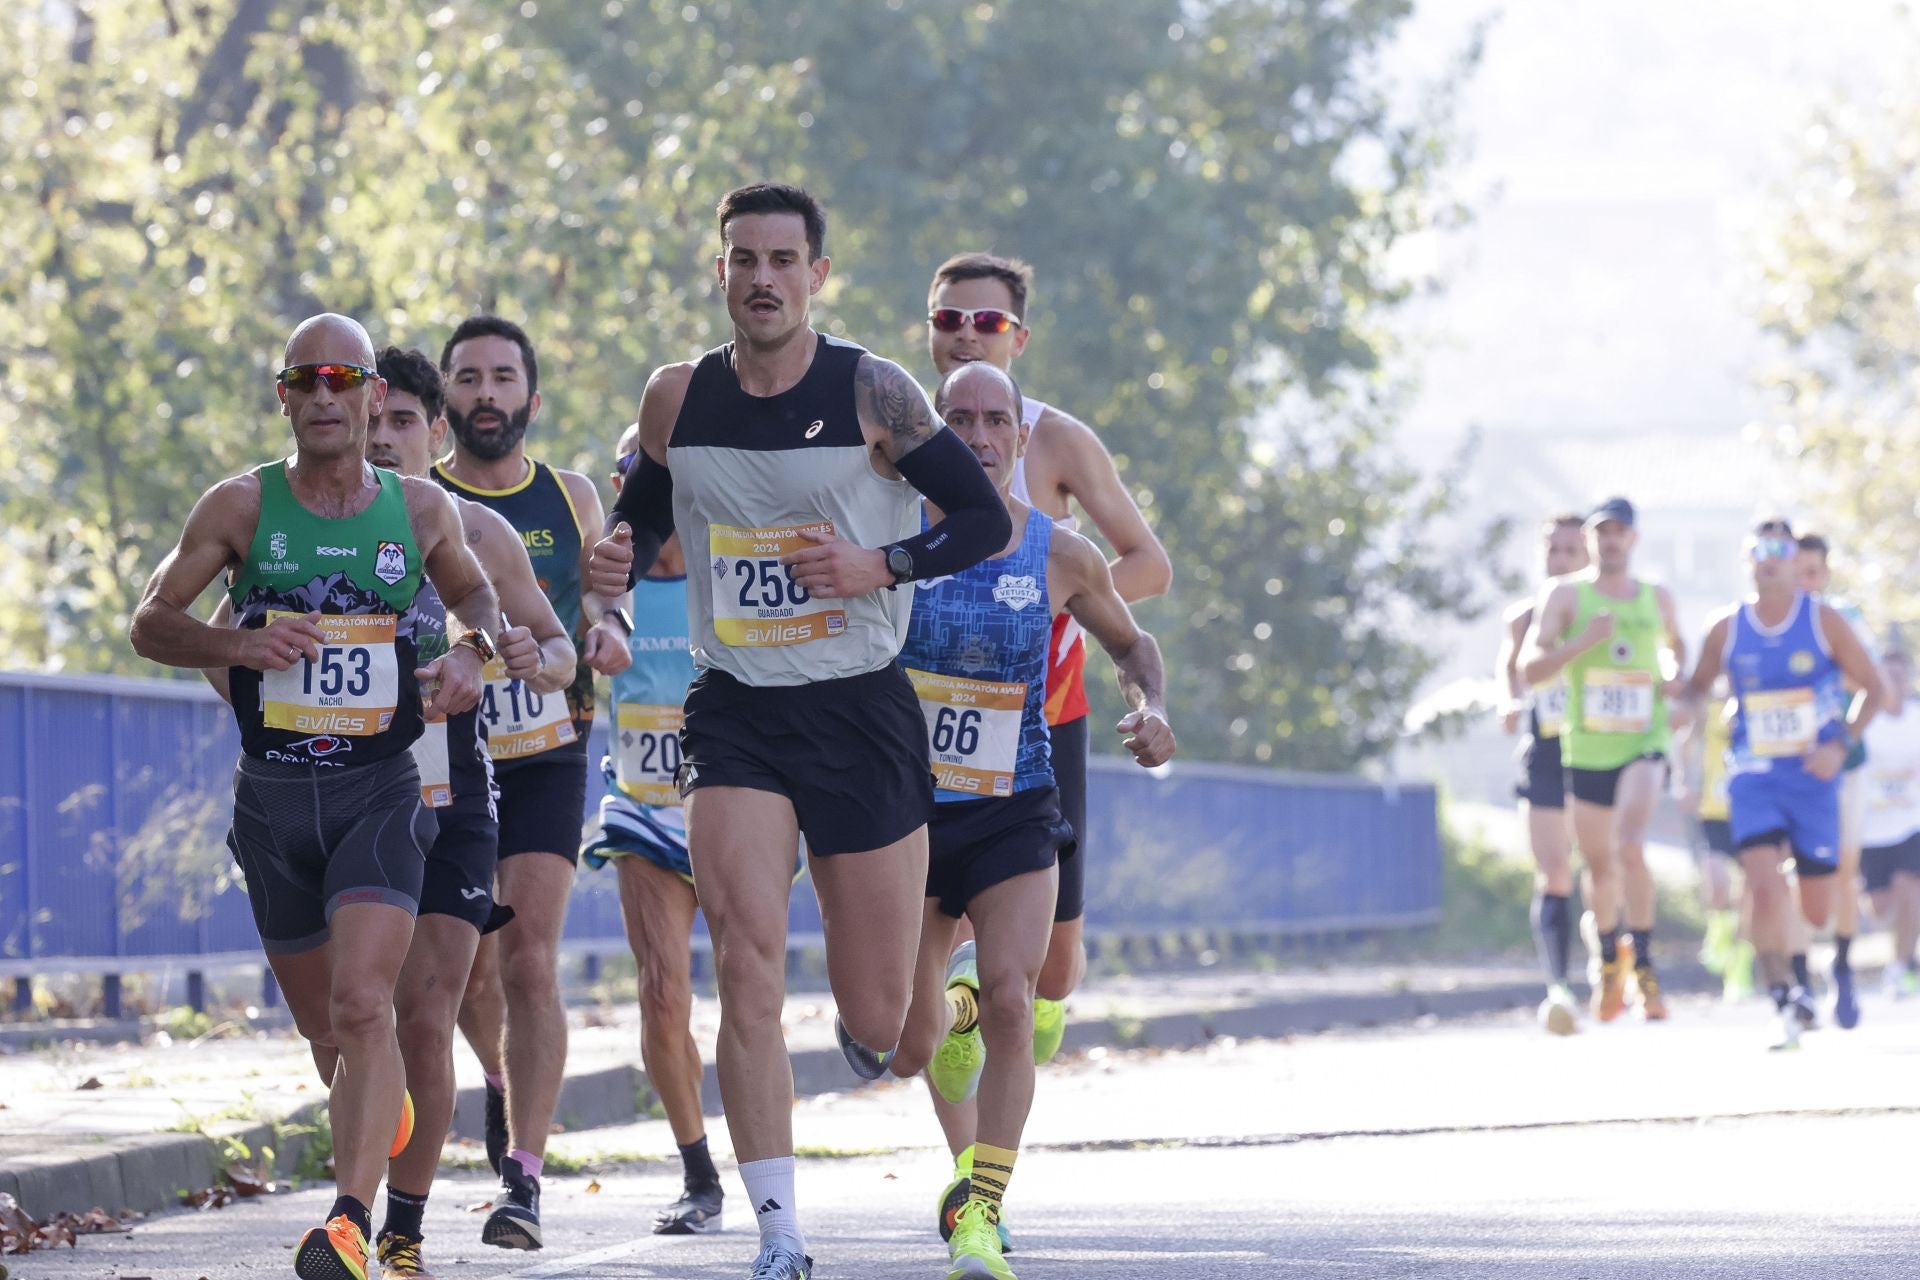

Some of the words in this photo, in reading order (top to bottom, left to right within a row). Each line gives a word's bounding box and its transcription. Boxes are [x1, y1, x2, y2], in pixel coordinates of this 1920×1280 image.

[518, 529, 554, 547] NES
[753, 543, 780, 552] 2024
[258, 561, 272, 571] Villa
[273, 561, 282, 571] de
[283, 561, 299, 573] Noja
[999, 590, 1036, 599] VETUSTA
[757, 607, 794, 618] GUARDADO
[324, 617, 368, 627] MARATÓN
[417, 612, 442, 630] NTE
[745, 623, 812, 643] avilés
[301, 647, 371, 697] 153
[956, 682, 998, 694] MARATÓN
[318, 696, 343, 707] NACHO
[950, 692, 977, 704] 2024
[294, 714, 366, 732] avilés
[932, 706, 982, 755] 66
[640, 733, 680, 773] 20
[937, 770, 981, 790] ilés
